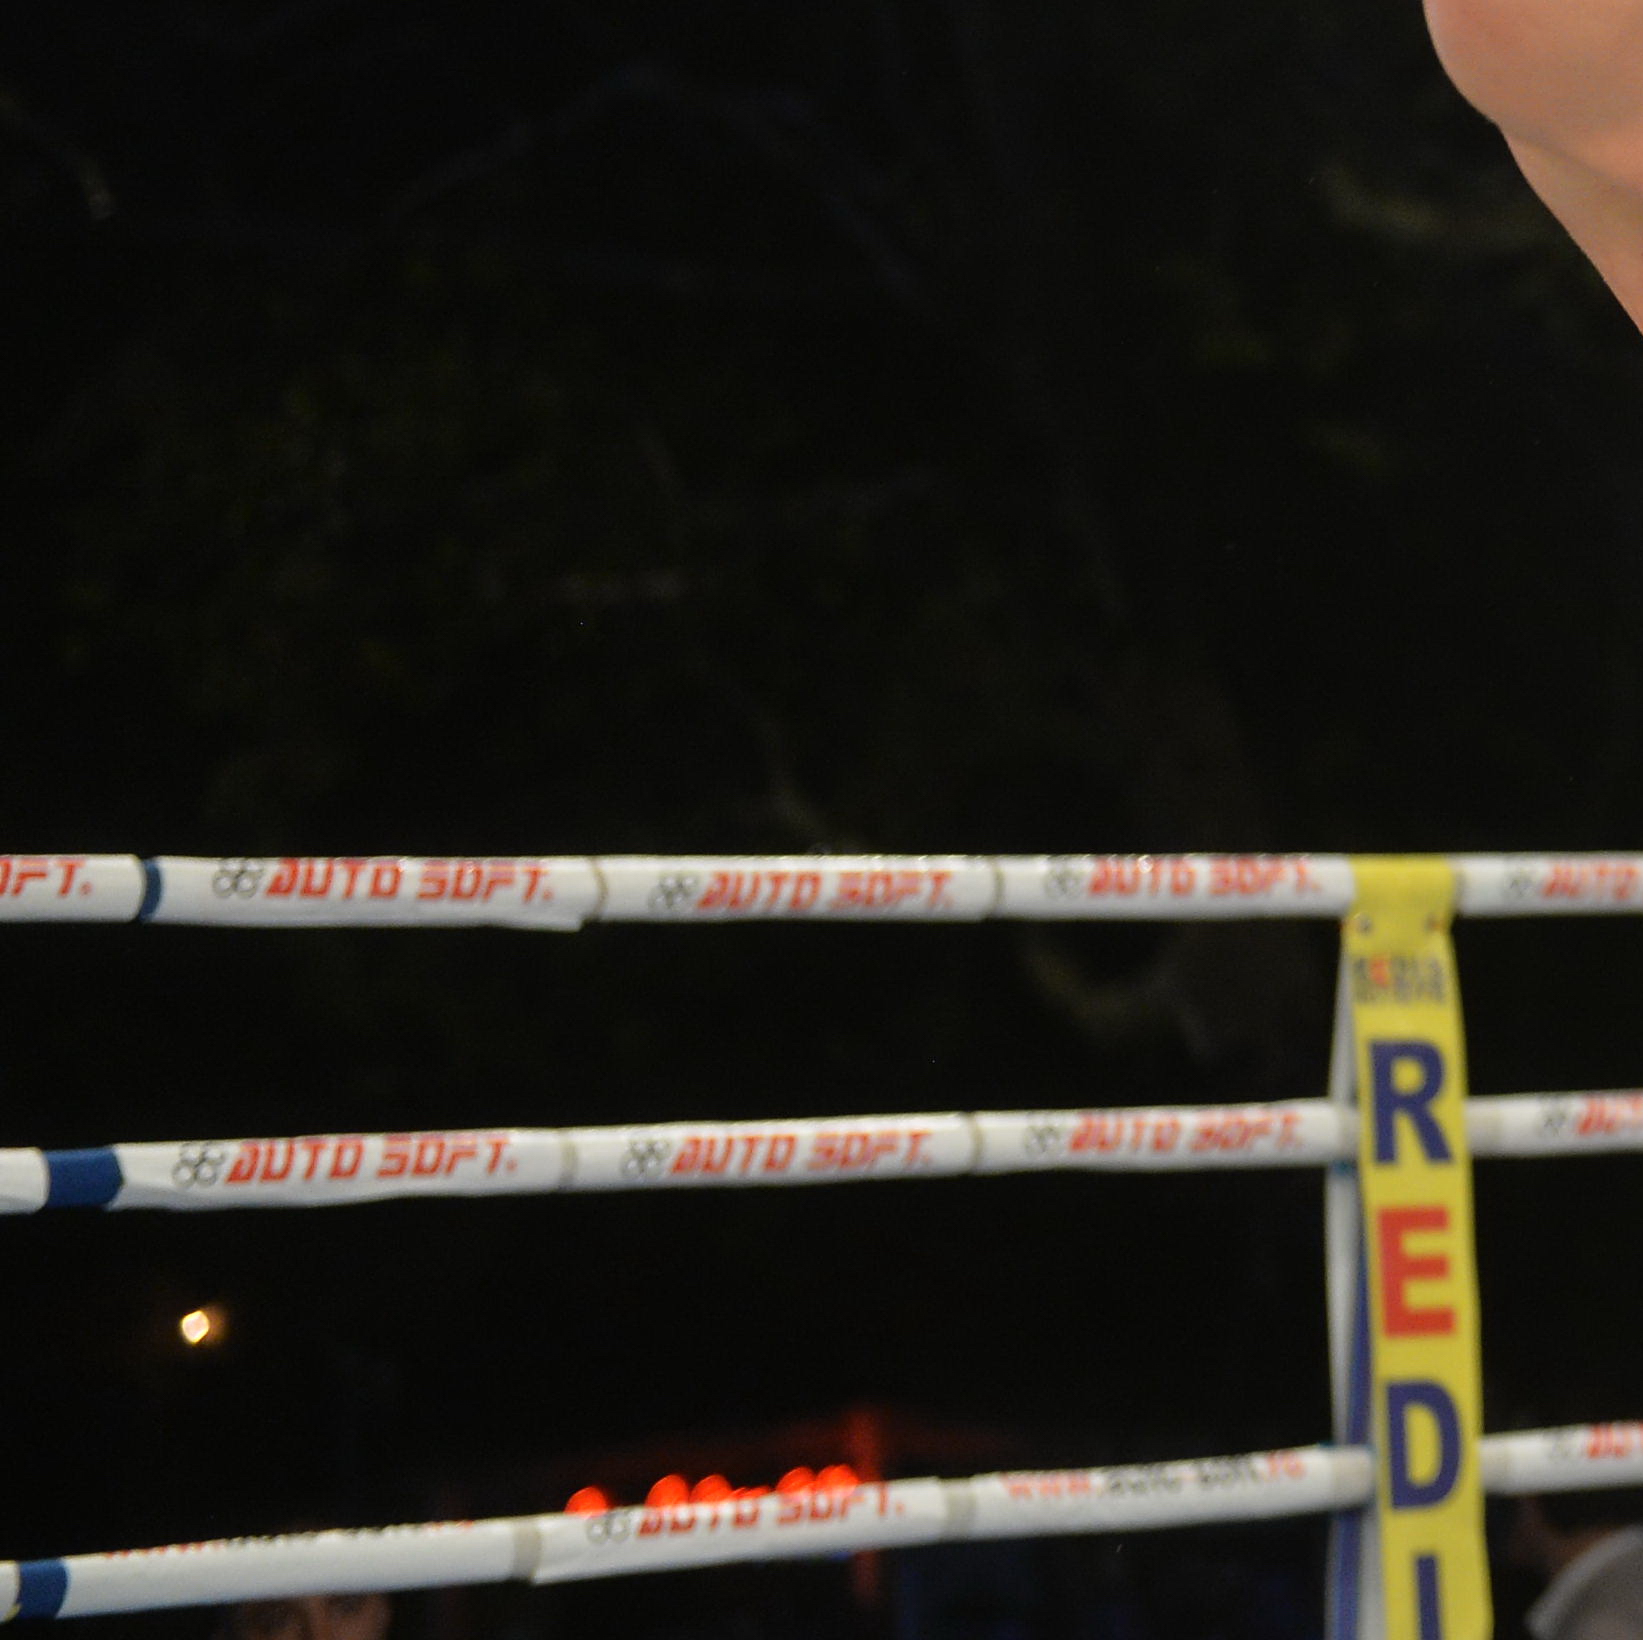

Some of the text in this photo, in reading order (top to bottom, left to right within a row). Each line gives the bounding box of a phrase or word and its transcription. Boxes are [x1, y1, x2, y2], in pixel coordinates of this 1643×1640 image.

[265, 857, 554, 903] AUTO SOFT.
[696, 869, 823, 911] AUTO
[225, 1131, 518, 1184] AUTO SOFT.
[669, 1135, 798, 1174] AUTO
[1369, 1039, 1462, 1640] REDI
